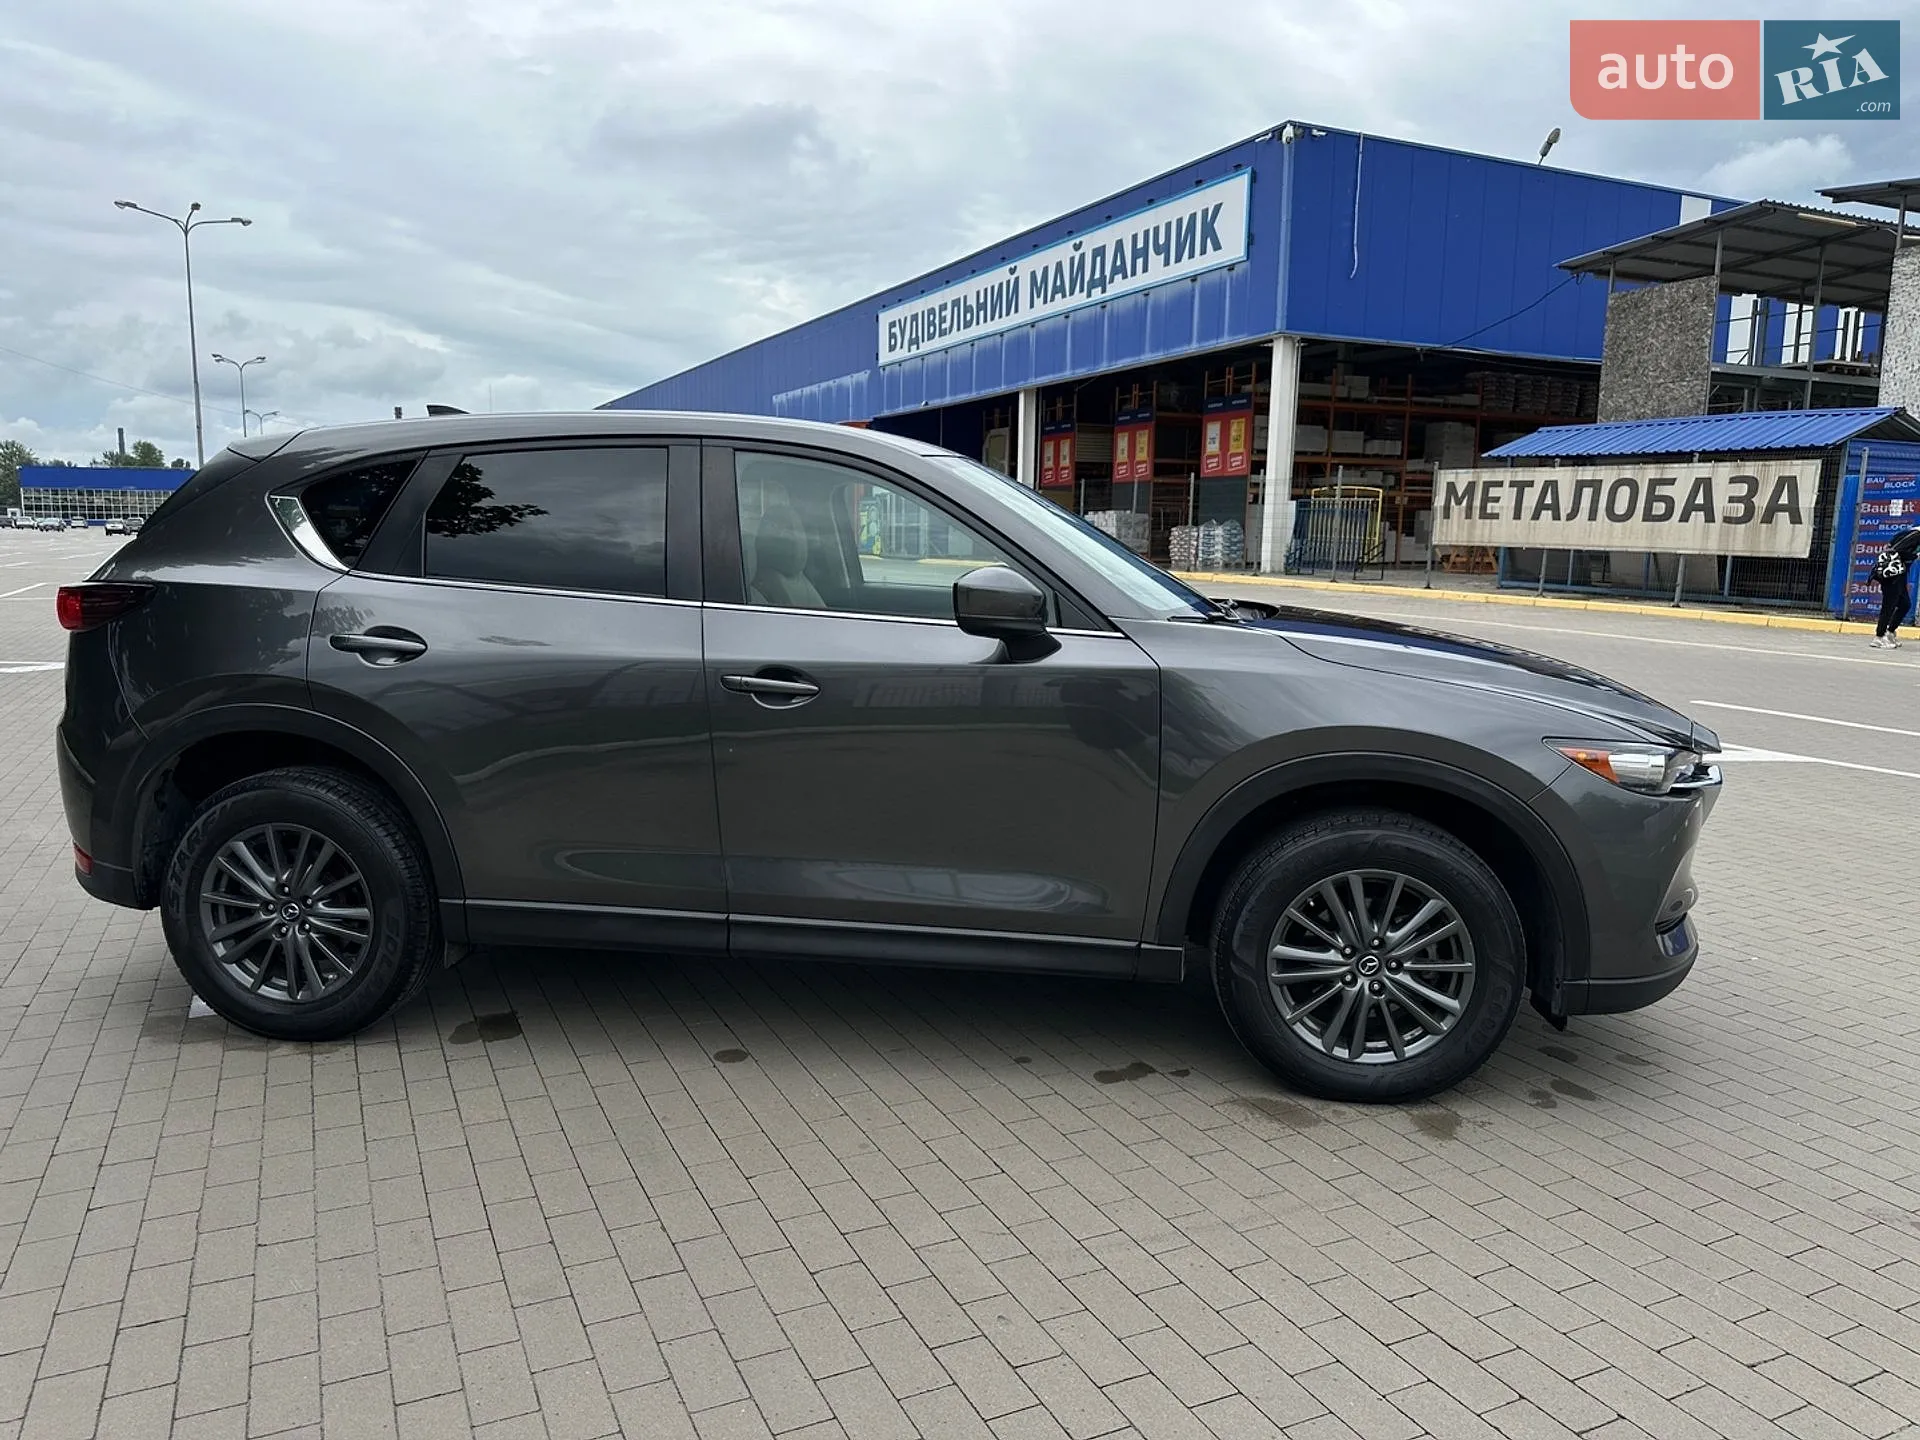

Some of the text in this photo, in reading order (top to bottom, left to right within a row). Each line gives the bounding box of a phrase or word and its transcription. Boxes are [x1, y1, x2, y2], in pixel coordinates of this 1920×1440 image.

[887, 202, 1224, 353] БУДІВЕЛЬНИЙ МАЙДАНЧИК
[1442, 475, 1803, 525] МЕТАЛОБАЗА
[1884, 480, 1916, 489] BLOCK
